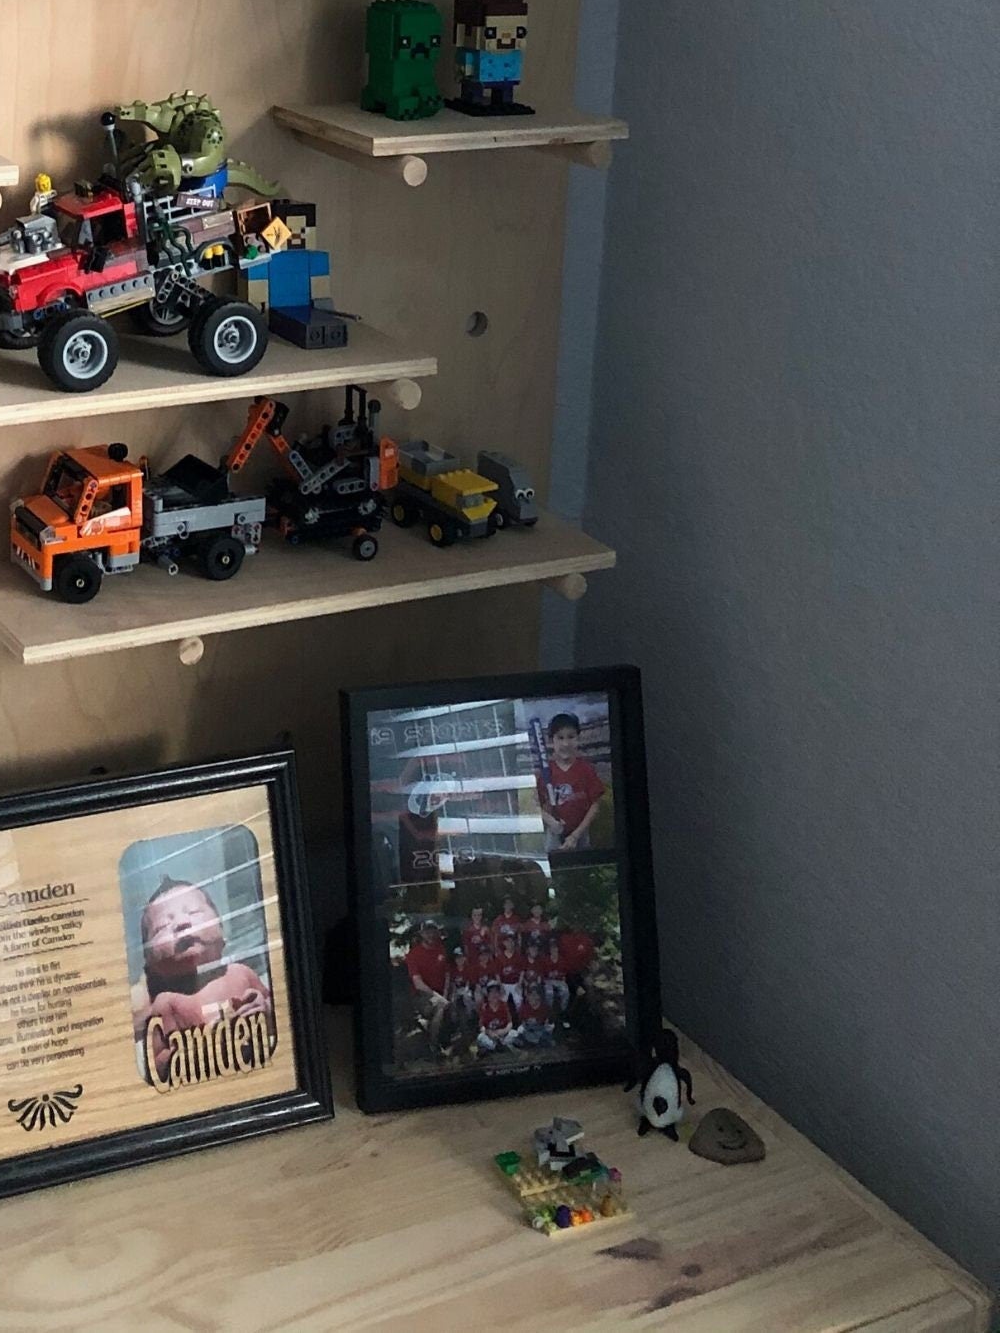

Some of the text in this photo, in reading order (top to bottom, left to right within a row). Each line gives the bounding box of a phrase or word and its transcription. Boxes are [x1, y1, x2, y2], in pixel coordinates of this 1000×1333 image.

[29, 924, 59, 937] winding
[32, 938, 40, 947] of
[41, 932, 75, 945] Camden
[9, 995, 21, 1005] not
[56, 1025, 69, 1035] and
[51, 1037, 69, 1049] hope
[147, 1000, 273, 1094] Camden
